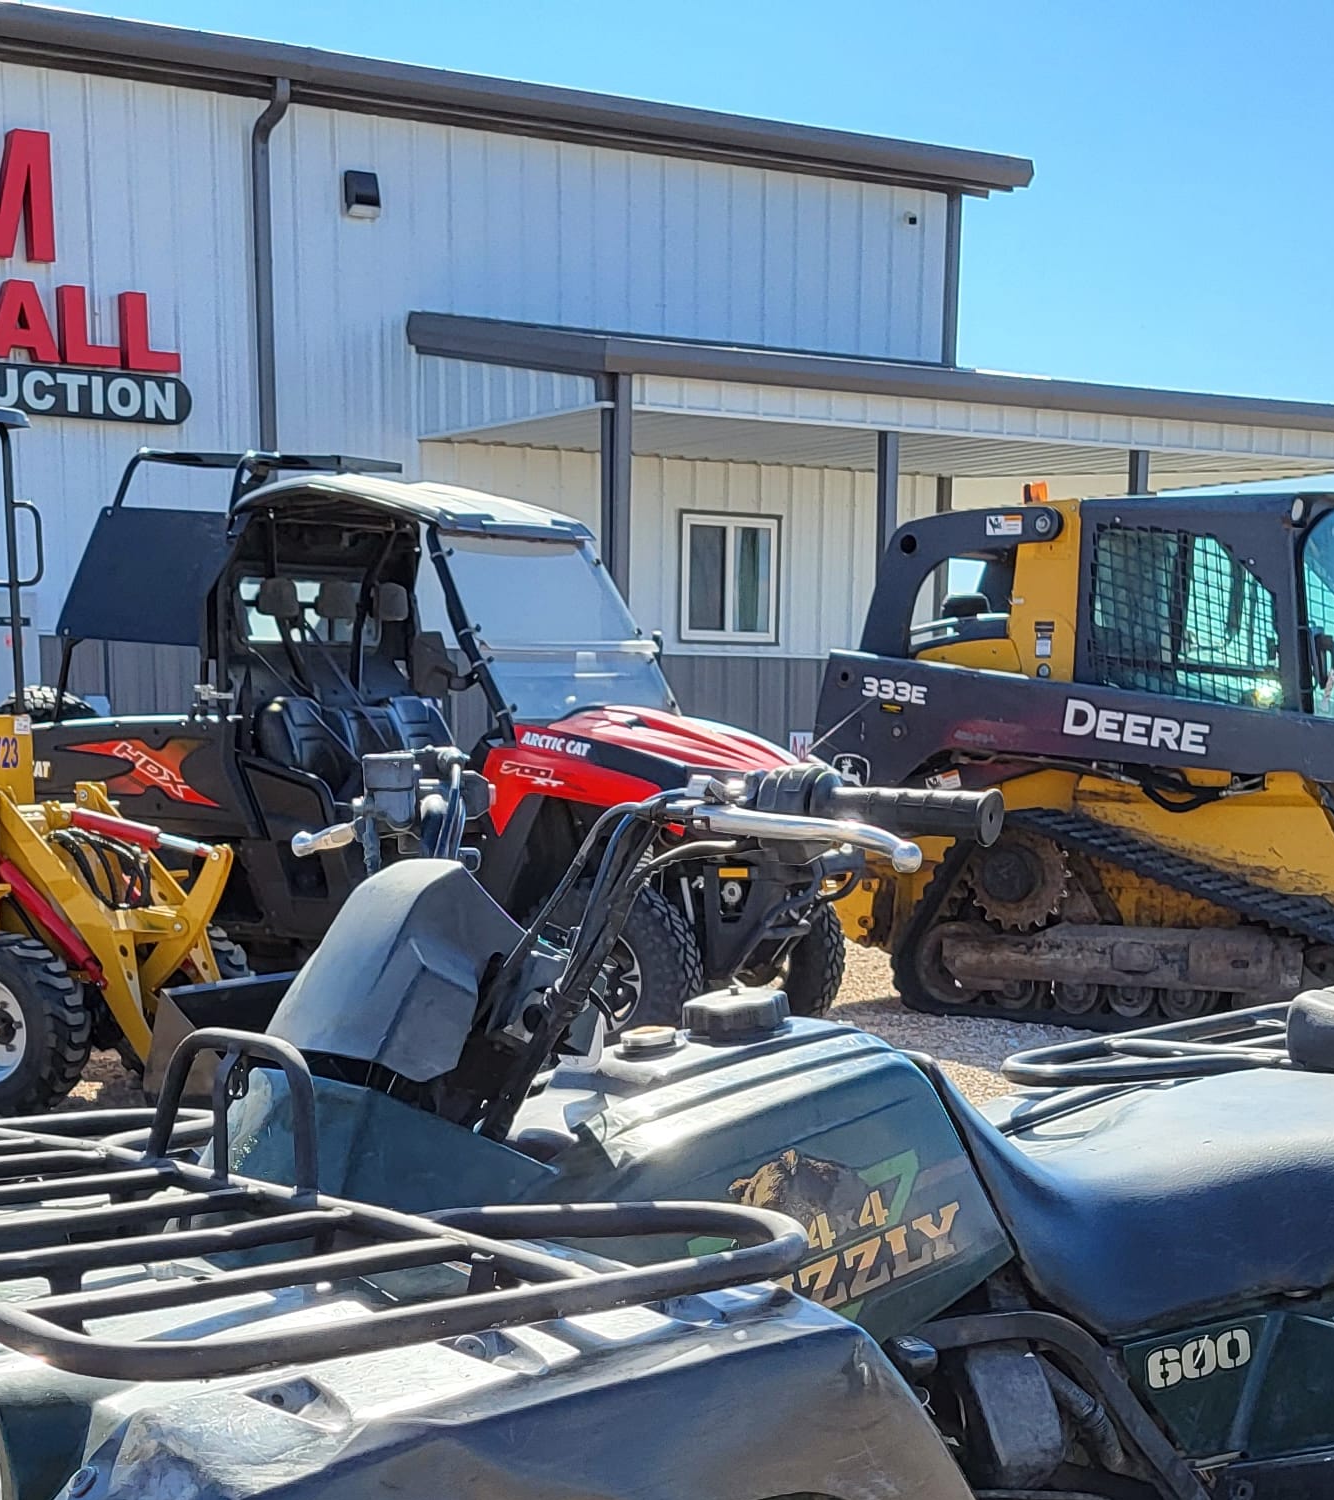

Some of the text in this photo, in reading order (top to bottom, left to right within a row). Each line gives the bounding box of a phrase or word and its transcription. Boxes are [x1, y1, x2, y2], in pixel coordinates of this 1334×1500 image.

[861, 676, 928, 705] 333E
[520, 731, 592, 757] ARCTIC CAT
[1062, 698, 1211, 755] DEERE
[32, 759, 51, 778] AT
[113, 741, 191, 798] HDX
[499, 760, 554, 780] 700
[808, 1190, 890, 1250] 4x4
[1147, 1328, 1251, 1389] 600
